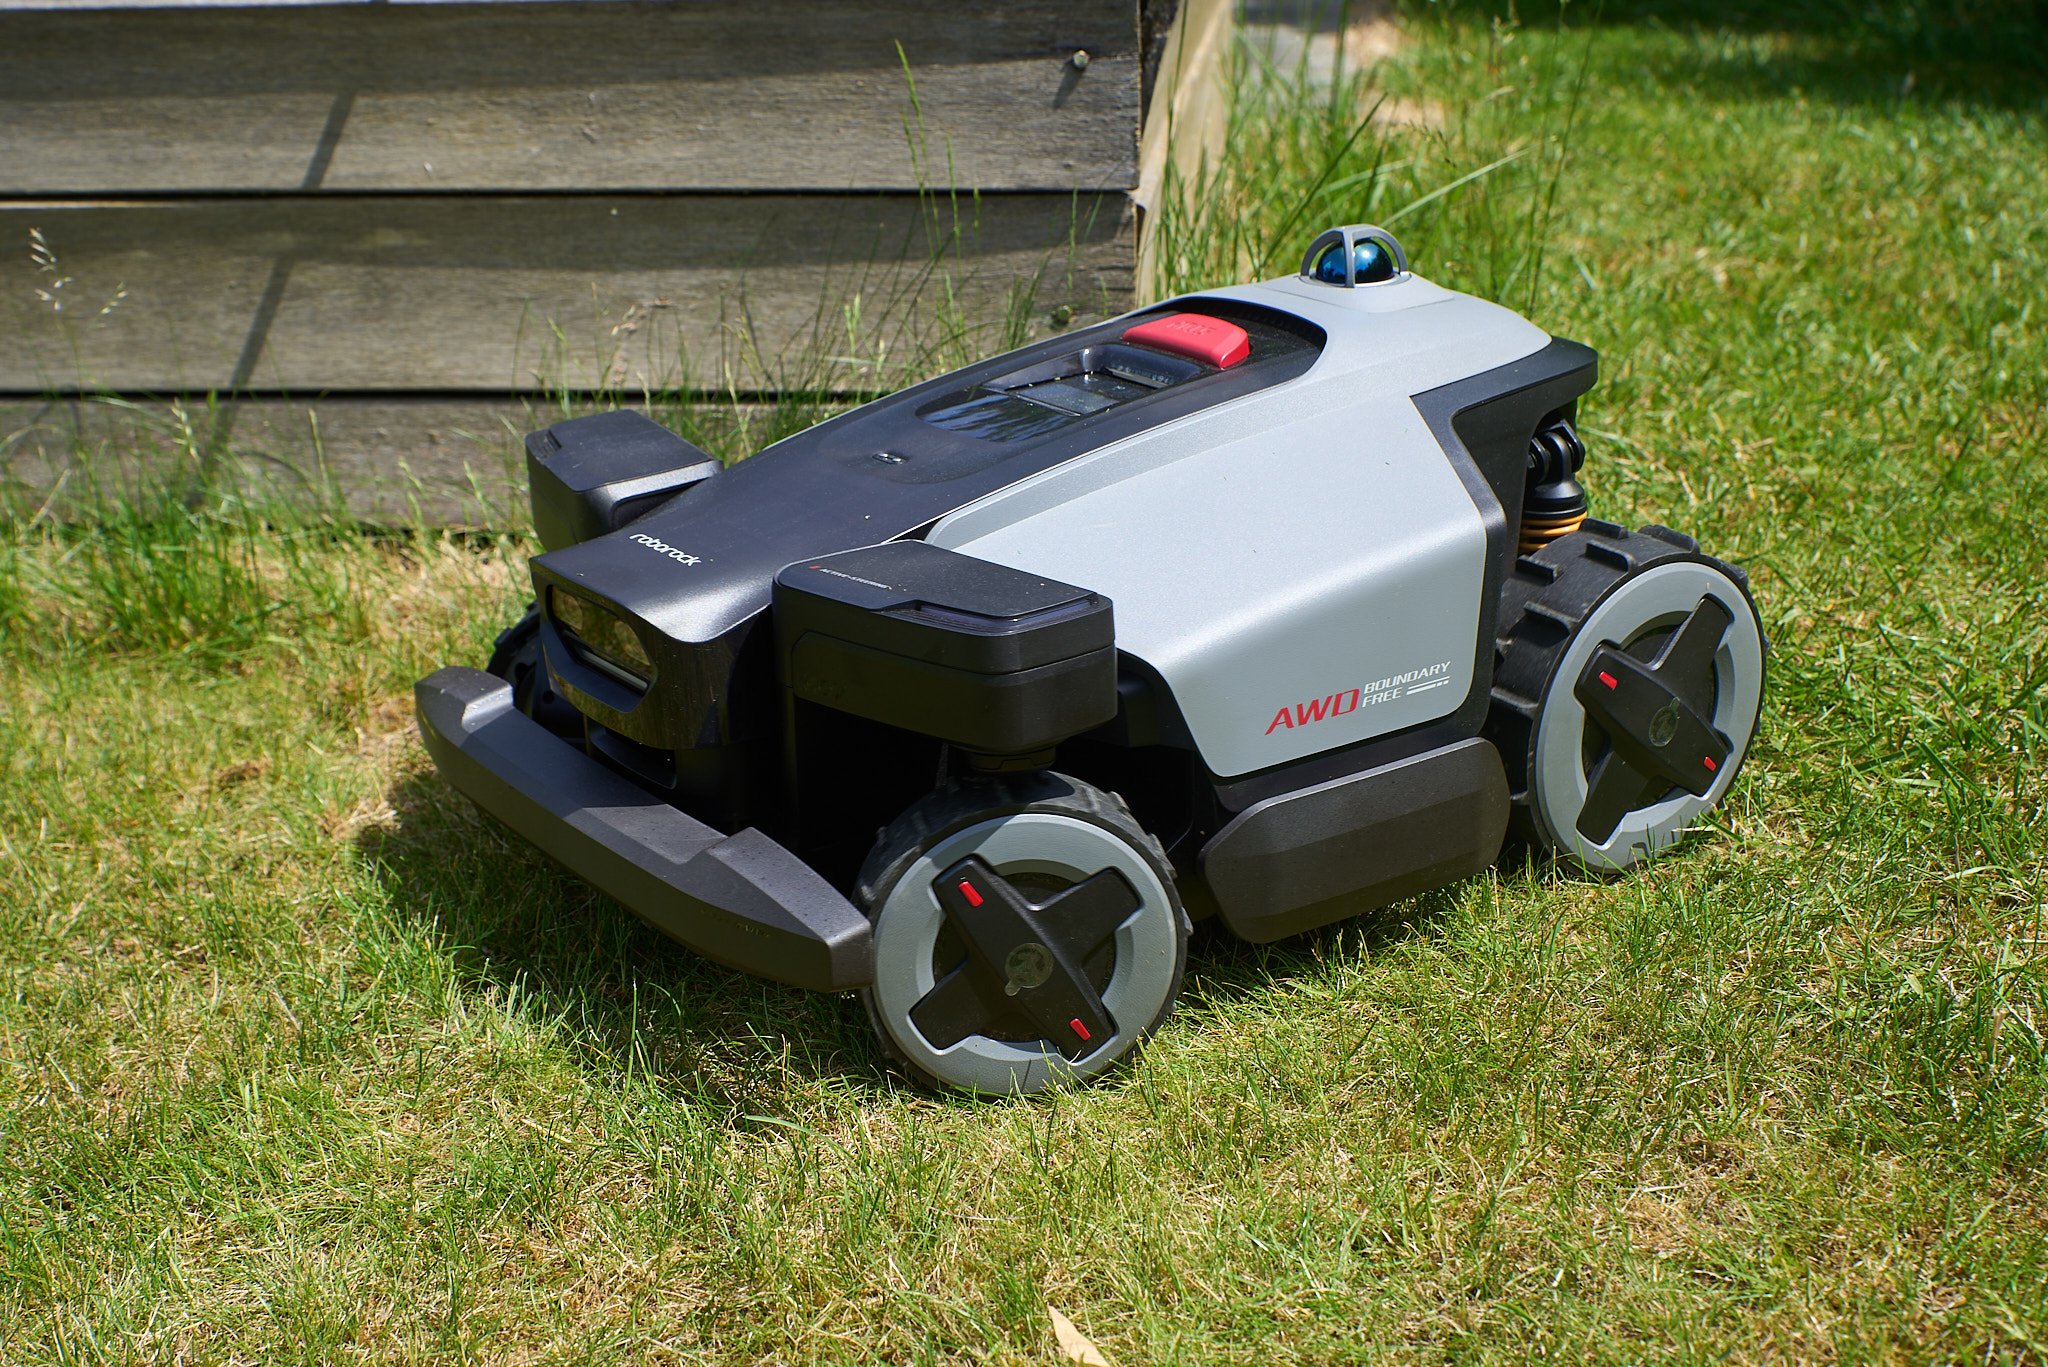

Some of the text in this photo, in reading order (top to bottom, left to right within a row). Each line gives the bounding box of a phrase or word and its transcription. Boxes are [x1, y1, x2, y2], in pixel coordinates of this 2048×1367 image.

[629, 533, 702, 567] roborock
[1363, 661, 1451, 694] BOUNDARY
[1264, 688, 1360, 735] AWD
[1362, 686, 1403, 708] FREE
